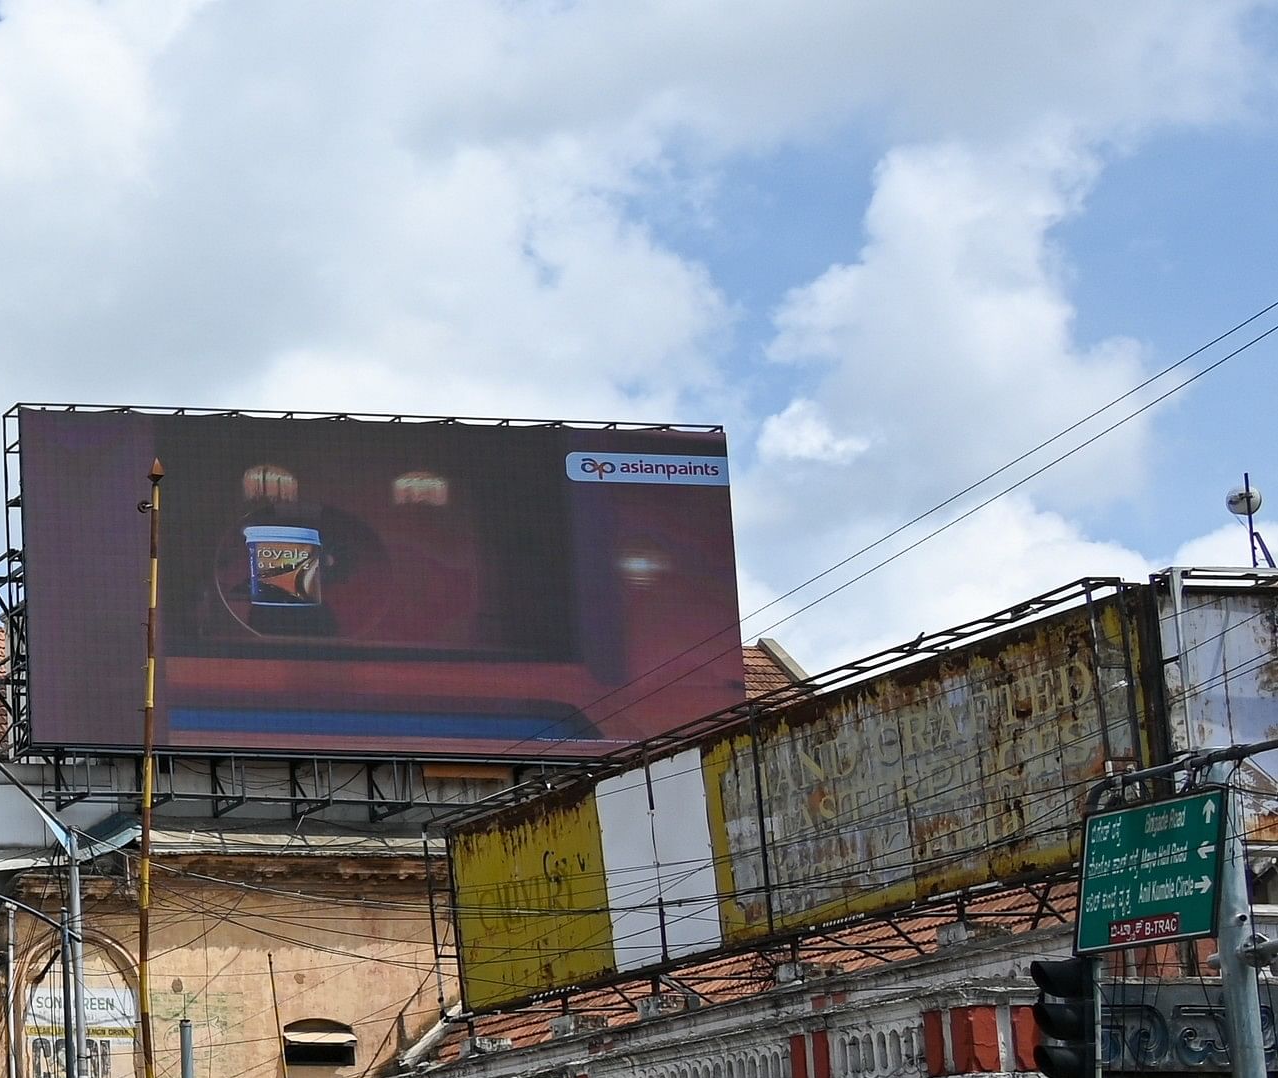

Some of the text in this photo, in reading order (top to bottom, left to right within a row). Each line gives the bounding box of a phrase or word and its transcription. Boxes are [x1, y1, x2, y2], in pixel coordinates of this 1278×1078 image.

[620, 459, 719, 481] asianpaints
[257, 547, 309, 560] royale
[1168, 806, 1186, 828] Road
[1140, 841, 1189, 873] Mayo Hall Road
[1138, 874, 1194, 904] Anil Kumble Circle
[1144, 917, 1177, 936] B-TRAC
